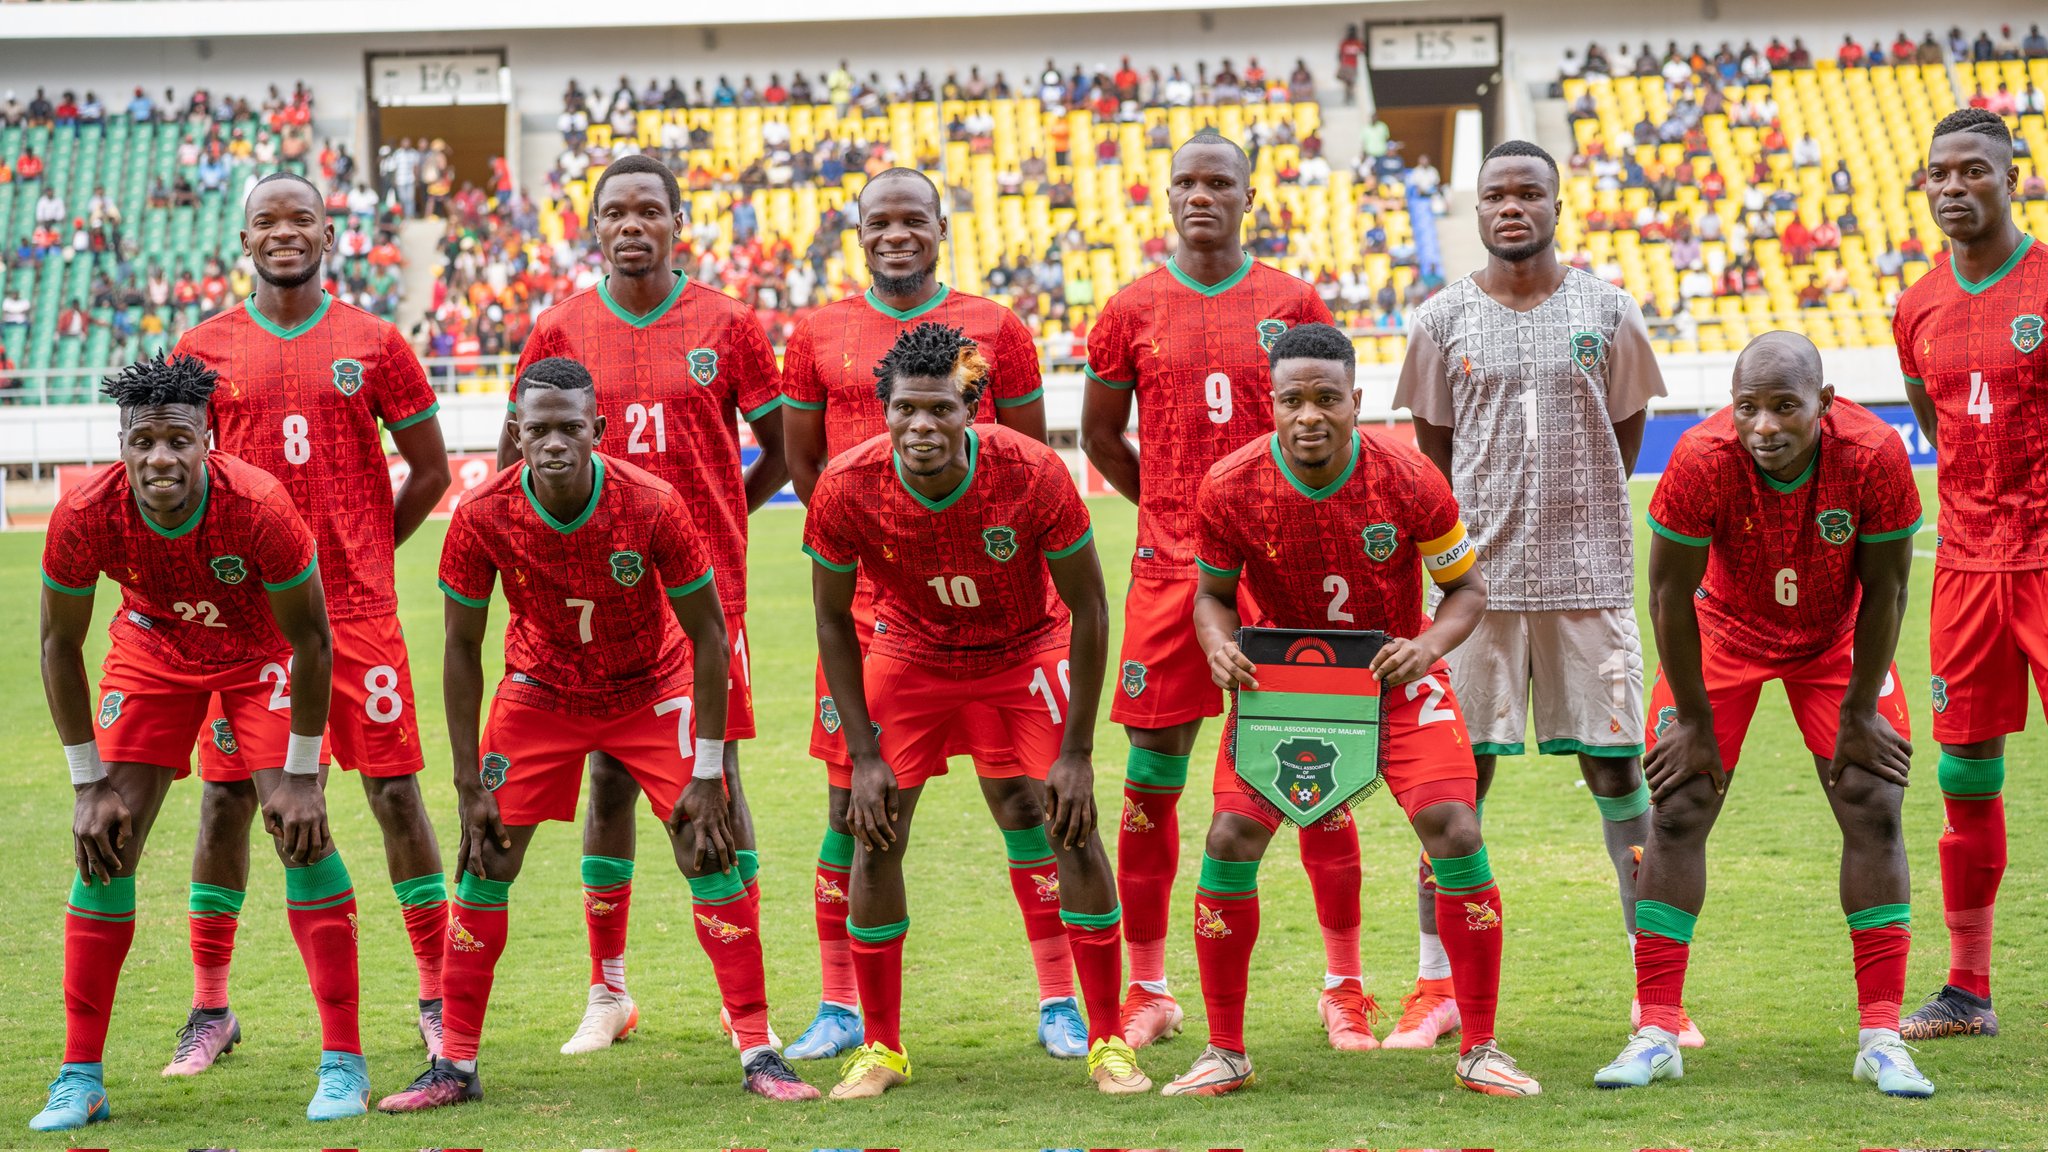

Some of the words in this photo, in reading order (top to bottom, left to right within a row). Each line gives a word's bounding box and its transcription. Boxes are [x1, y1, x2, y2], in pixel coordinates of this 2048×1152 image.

[1415, 30, 1456, 61] E5
[419, 62, 462, 93] E6
[1205, 373, 1233, 424] 9
[1518, 389, 1537, 440] 1
[1968, 372, 1993, 424] 4
[283, 415, 311, 465] 8
[626, 403, 667, 454] 21
[1436, 537, 1471, 566] CAPTA
[927, 575, 980, 608] 10
[1323, 575, 1354, 623] 2
[1775, 568, 1798, 607] 6
[173, 601, 228, 628] 22
[565, 598, 595, 644] 7
[364, 665, 403, 723] 8
[1405, 674, 1456, 727] 2
[1598, 650, 1625, 709] 1
[653, 696, 694, 759] 7
[1250, 724, 1282, 732] FOOTBALL
[1284, 726, 1326, 734] ASSOCIATION
[1338, 728, 1366, 736] MALAWI
[1281, 760, 1303, 770] FOOTBALL
[1303, 762, 1331, 771] ASSOCIATION
